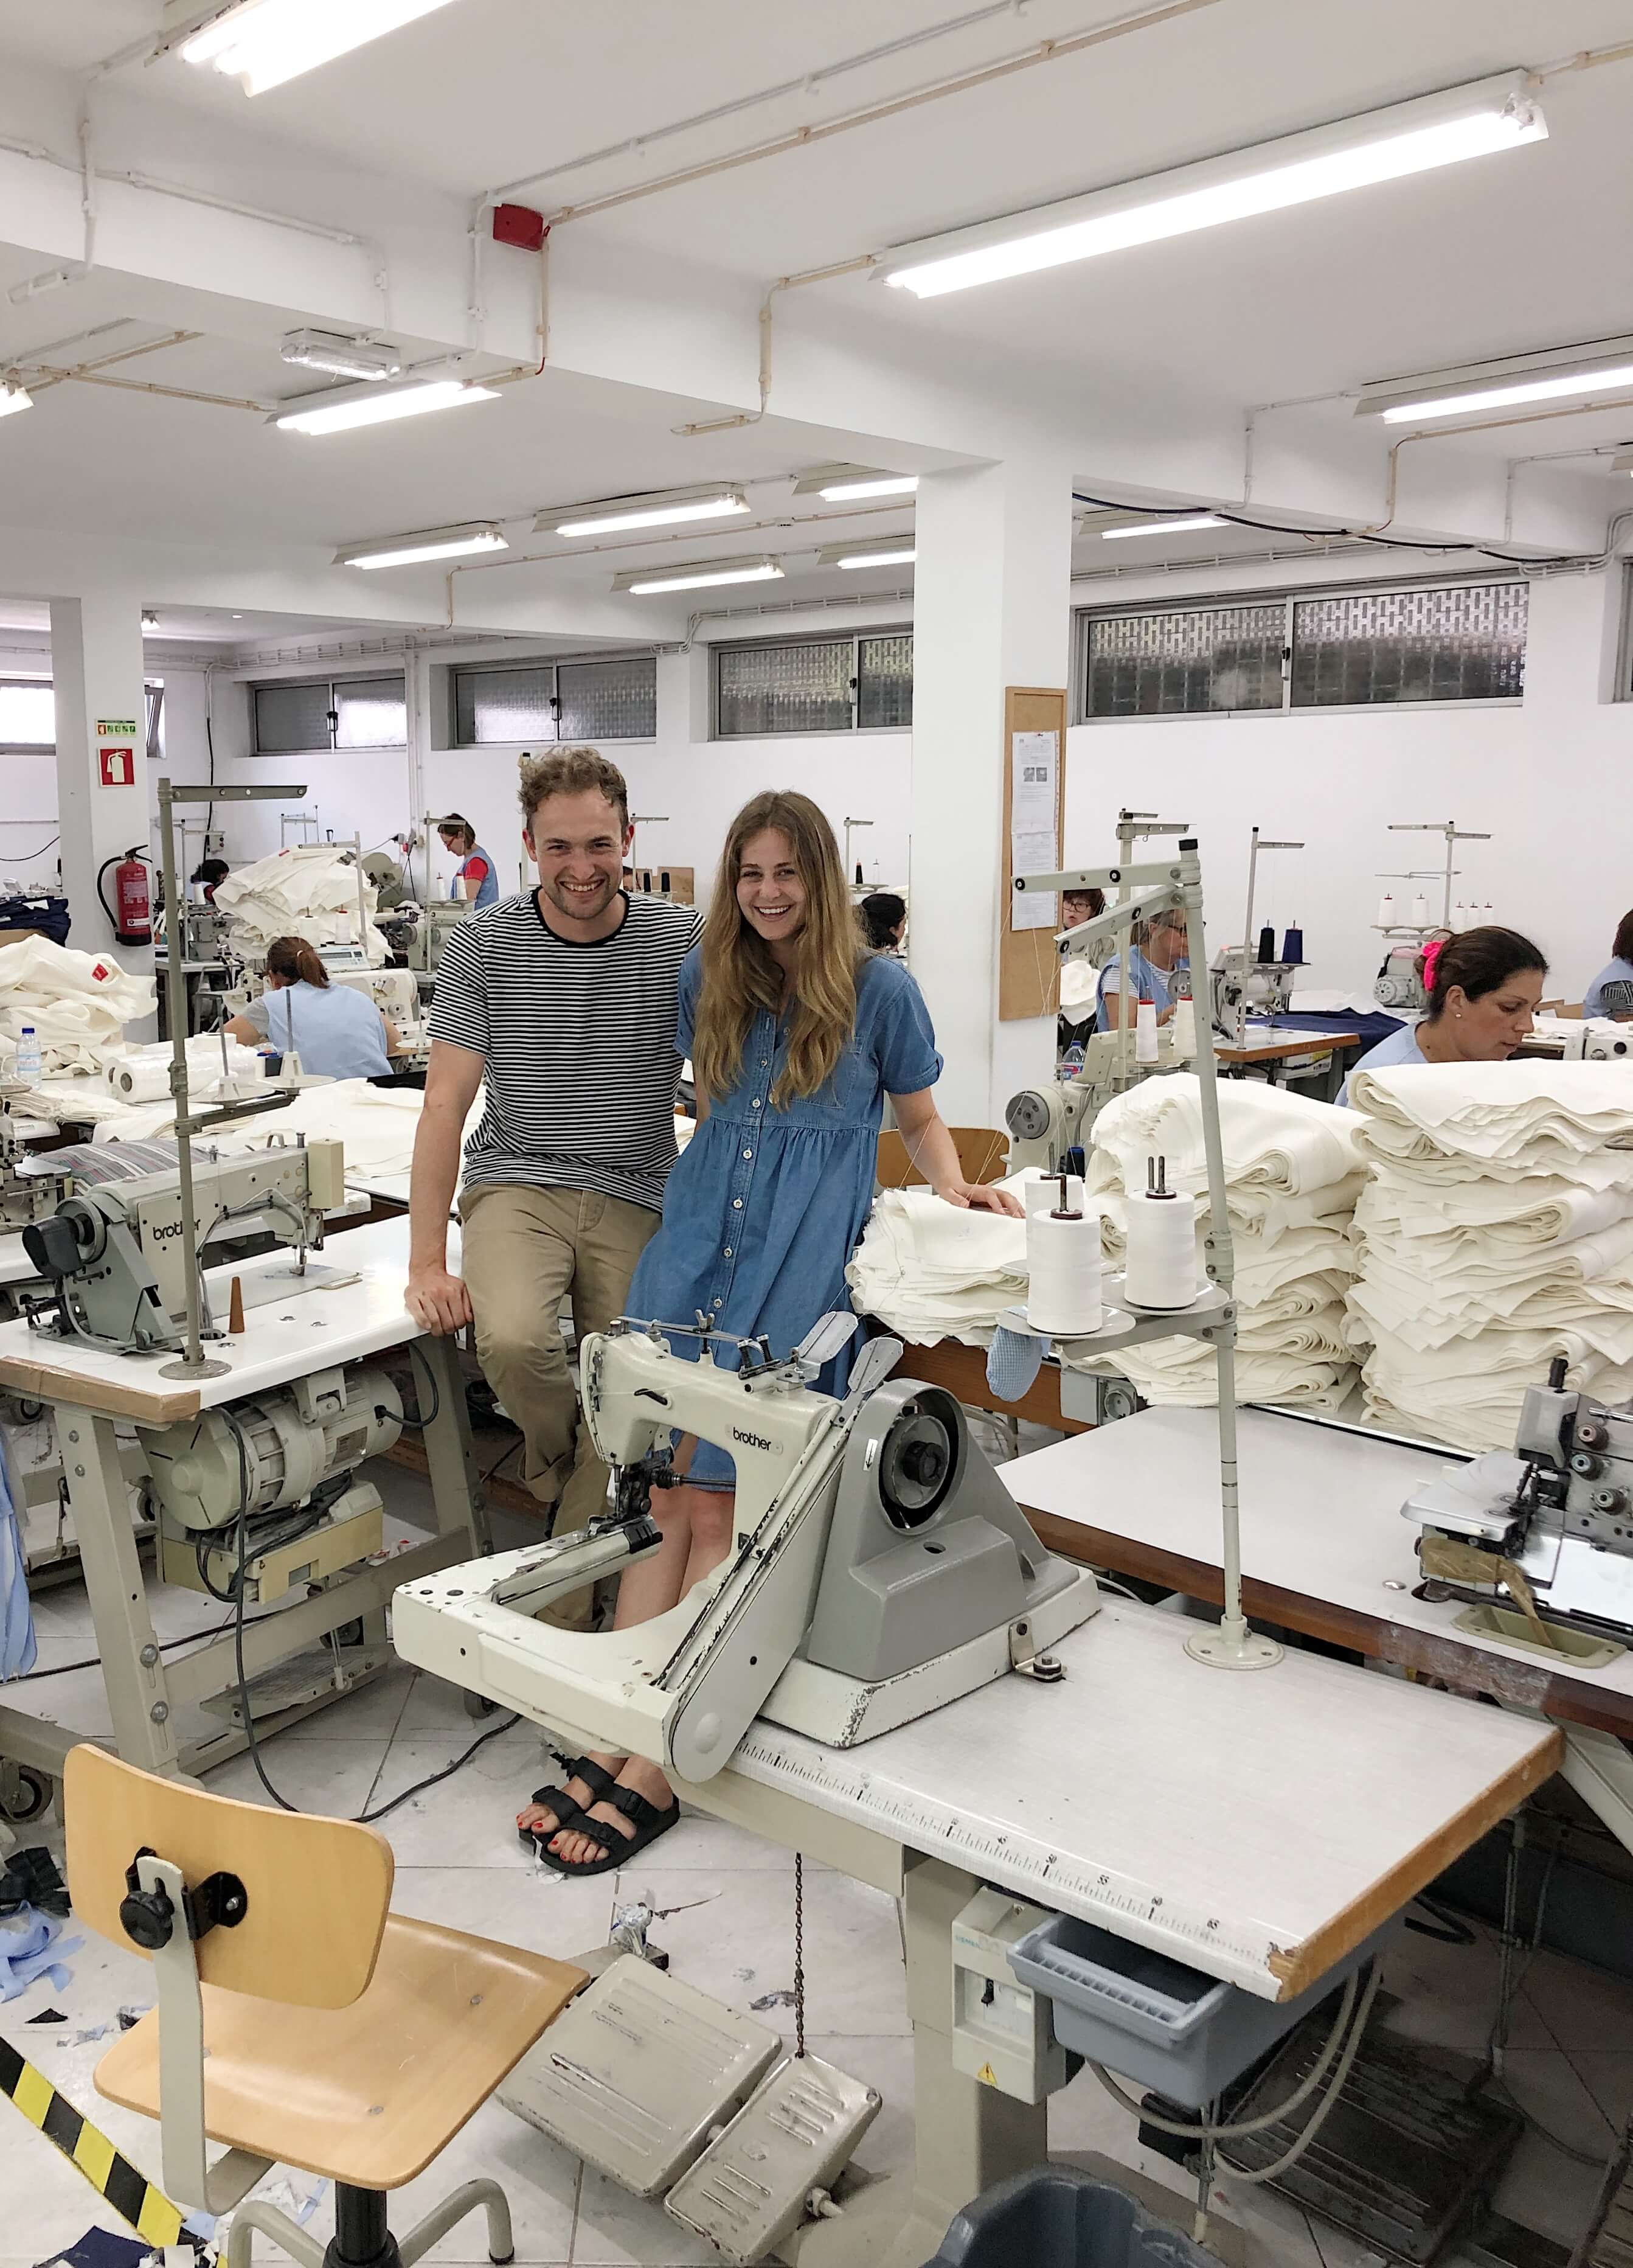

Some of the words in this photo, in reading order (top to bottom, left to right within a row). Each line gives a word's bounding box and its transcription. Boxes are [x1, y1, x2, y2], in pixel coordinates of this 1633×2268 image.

[153, 1219, 201, 1240] brotr
[733, 1427, 772, 1451] brother
[1045, 1853, 1057, 1864] 50
[1097, 1874, 1109, 1885] 55
[1151, 1896, 1163, 1906] 60
[1207, 1919, 1220, 1930] 65
